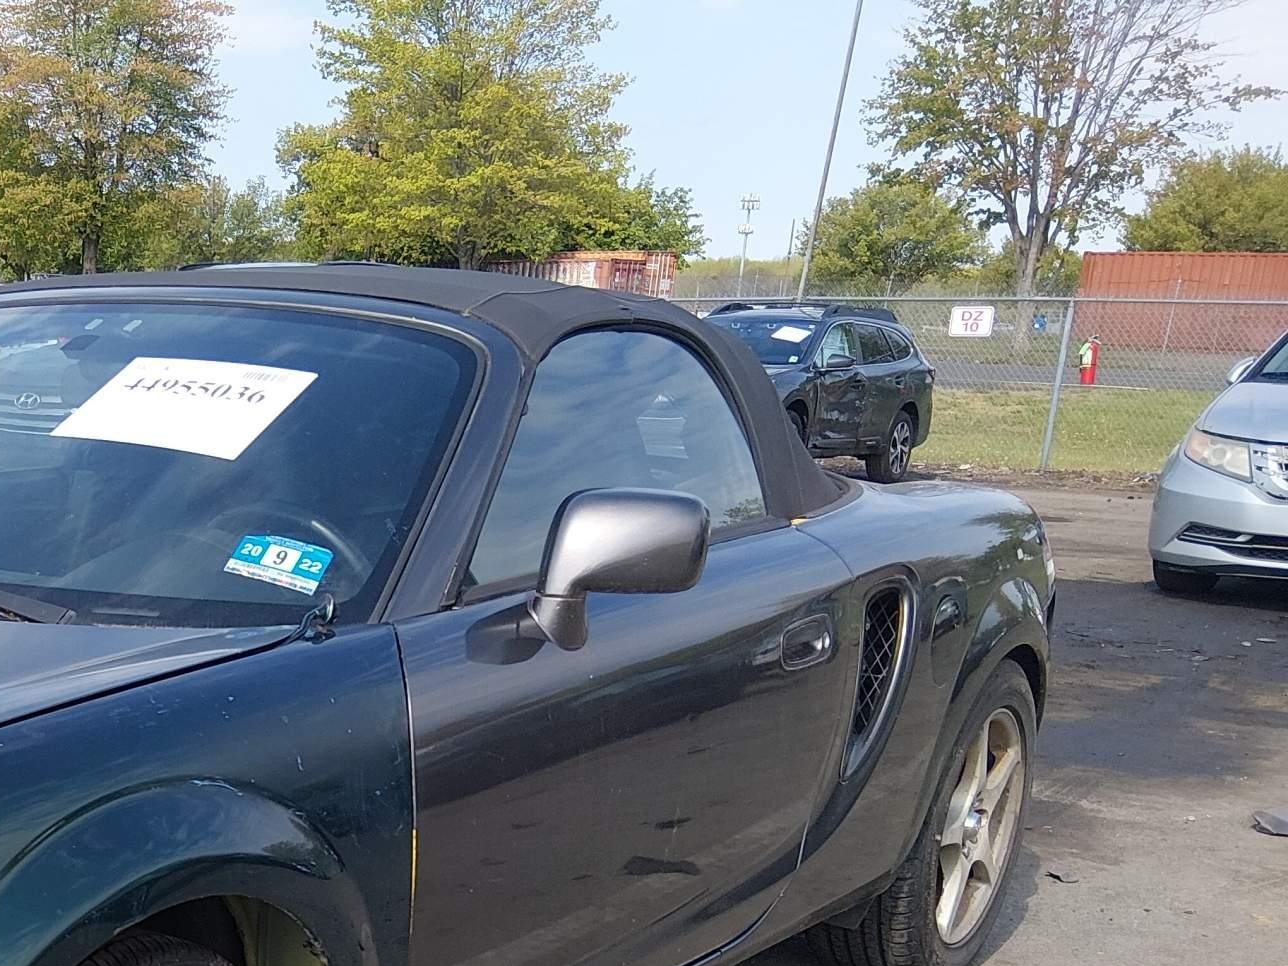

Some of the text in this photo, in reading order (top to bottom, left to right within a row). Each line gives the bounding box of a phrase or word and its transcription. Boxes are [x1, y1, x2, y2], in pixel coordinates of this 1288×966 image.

[961, 310, 985, 321] DZ
[961, 322, 979, 332] 10
[124, 377, 266, 404] 44955036
[240, 543, 263, 557] 20
[273, 550, 288, 566] 9
[299, 558, 323, 573] 22
